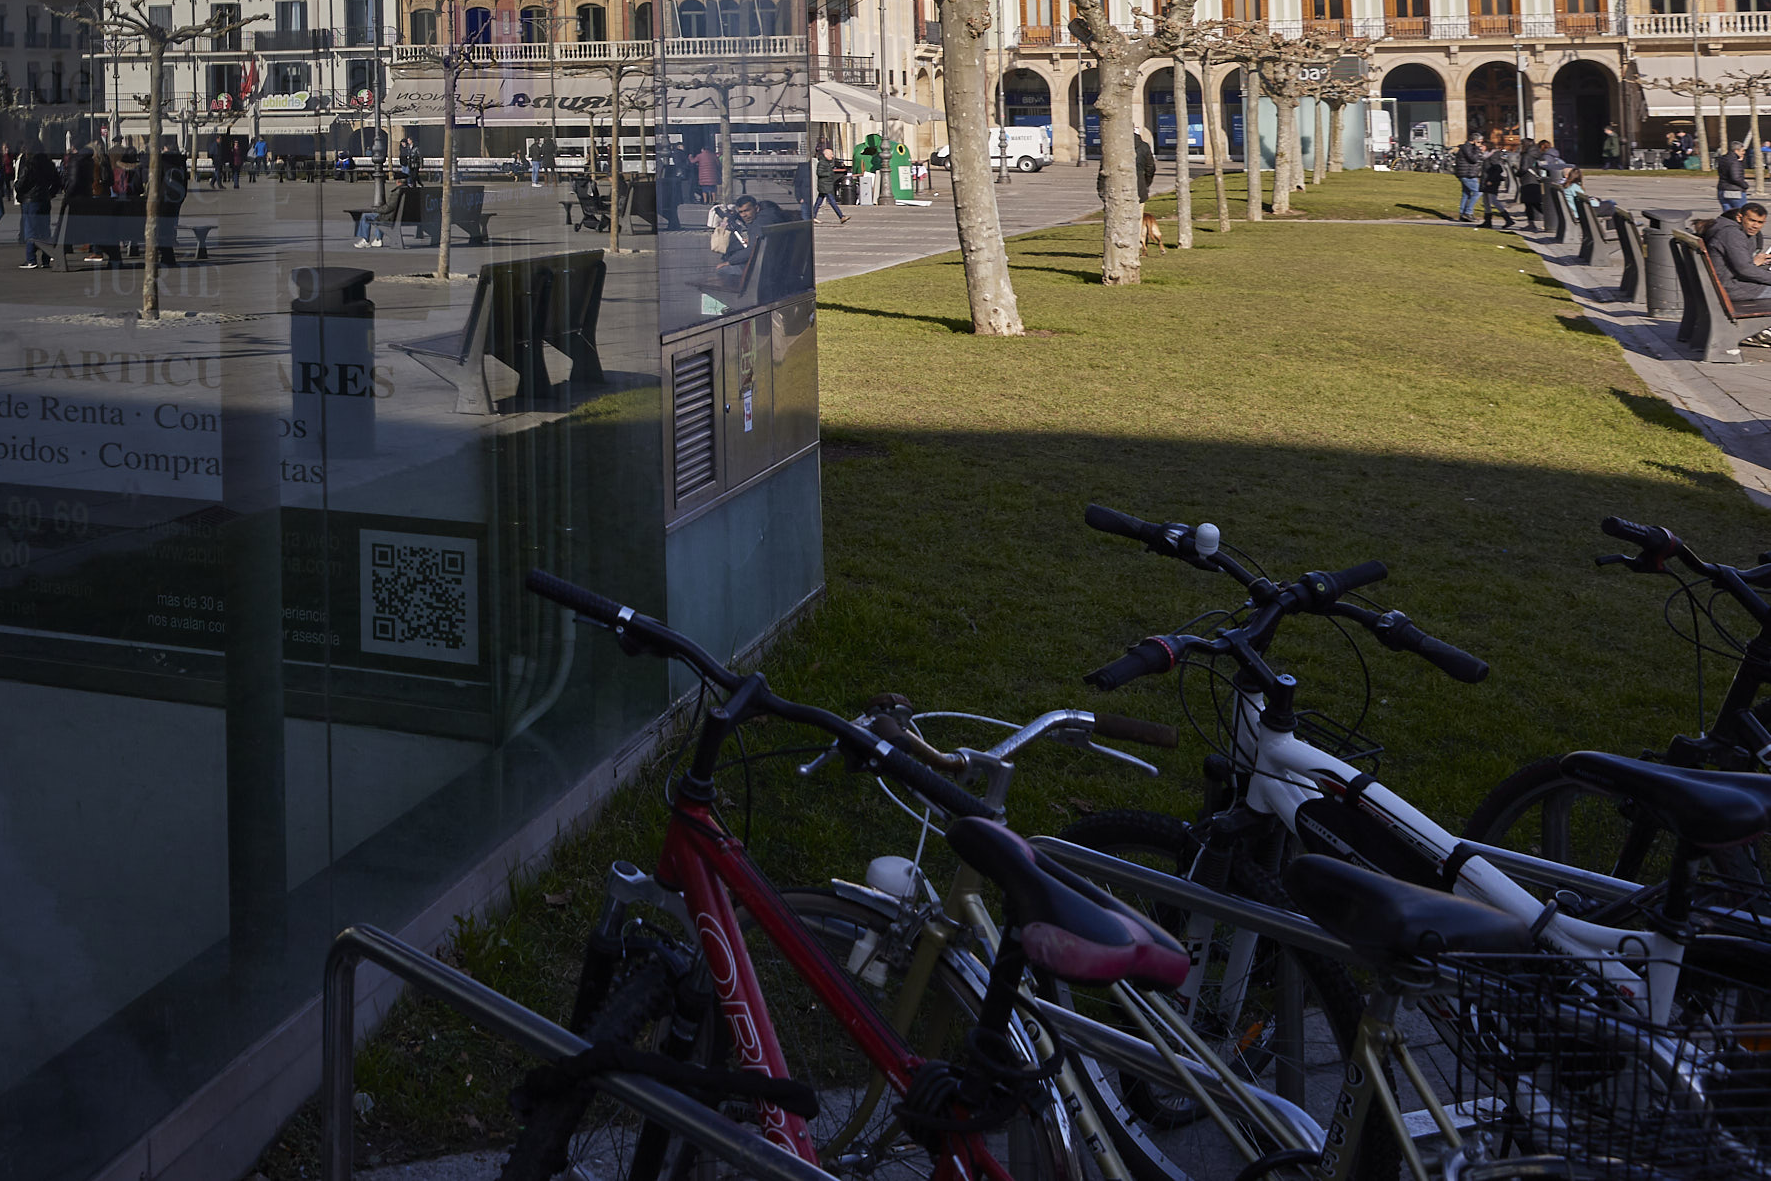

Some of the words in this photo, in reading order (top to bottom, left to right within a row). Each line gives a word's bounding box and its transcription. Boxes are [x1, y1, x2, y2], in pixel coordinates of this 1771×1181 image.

[23, 348, 396, 399] PARTICUARES
[40, 396, 124, 427] Renta
[154, 403, 307, 439] Conos
[98, 442, 325, 485] Compratas
[6, 495, 42, 533] 90
[53, 499, 89, 535] 69
[157, 591, 180, 608] más
[183, 593, 198, 609] de
[200, 595, 214, 611] 30
[147, 613, 167, 627] nos
[170, 615, 205, 632] avalan
[291, 629, 341, 647] asesoía
[1318, 1060, 1364, 1181] ORBE
